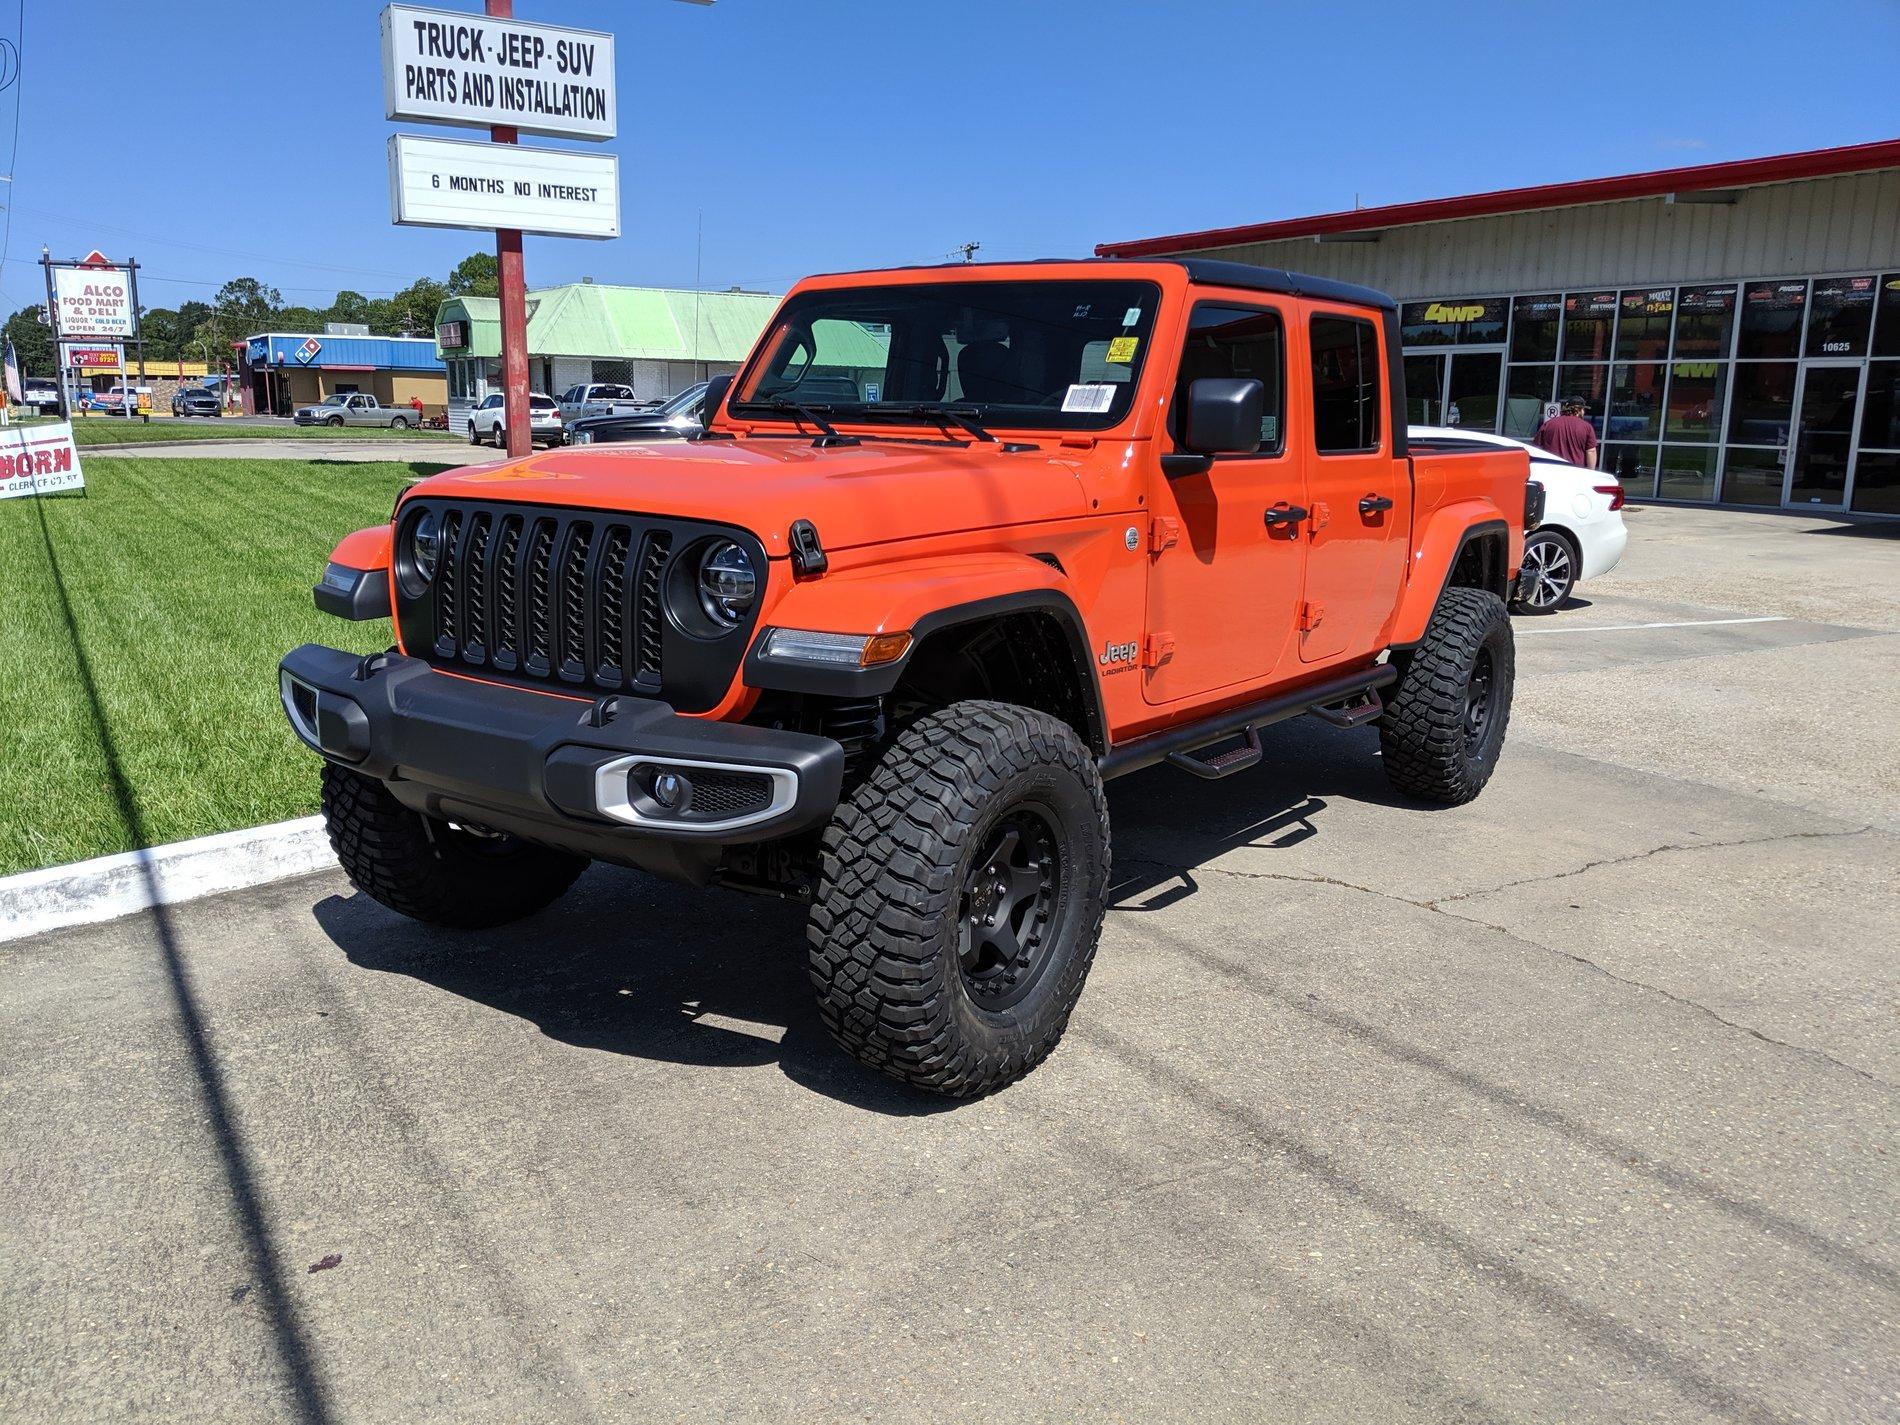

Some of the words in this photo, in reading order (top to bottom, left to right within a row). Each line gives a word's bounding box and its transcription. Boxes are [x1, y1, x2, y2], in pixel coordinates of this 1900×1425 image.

[413, 20, 486, 63] TRUCK
[496, 32, 545, 69] JEEP
[556, 39, 595, 77] SUV
[405, 64, 457, 104] PARTS
[462, 71, 494, 108] AND
[499, 76, 606, 121] INSTALLATION
[431, 174, 440, 188] 6
[449, 175, 505, 195] MONTHS
[513, 181, 531, 196] NO
[538, 183, 598, 202] INTEREST
[83, 284, 124, 297] ALCO
[62, 297, 93, 306] FOOD
[95, 298, 125, 307] MART
[73, 306, 83, 316] &
[88, 307, 117, 316] DELI
[1424, 303, 1485, 323] 4WP
[64, 316, 89, 324] LIQUOR
[1822, 342, 1850, 352] 10625
[9, 479, 34, 492] CLERK
[1099, 640, 1139, 665] Jeep
